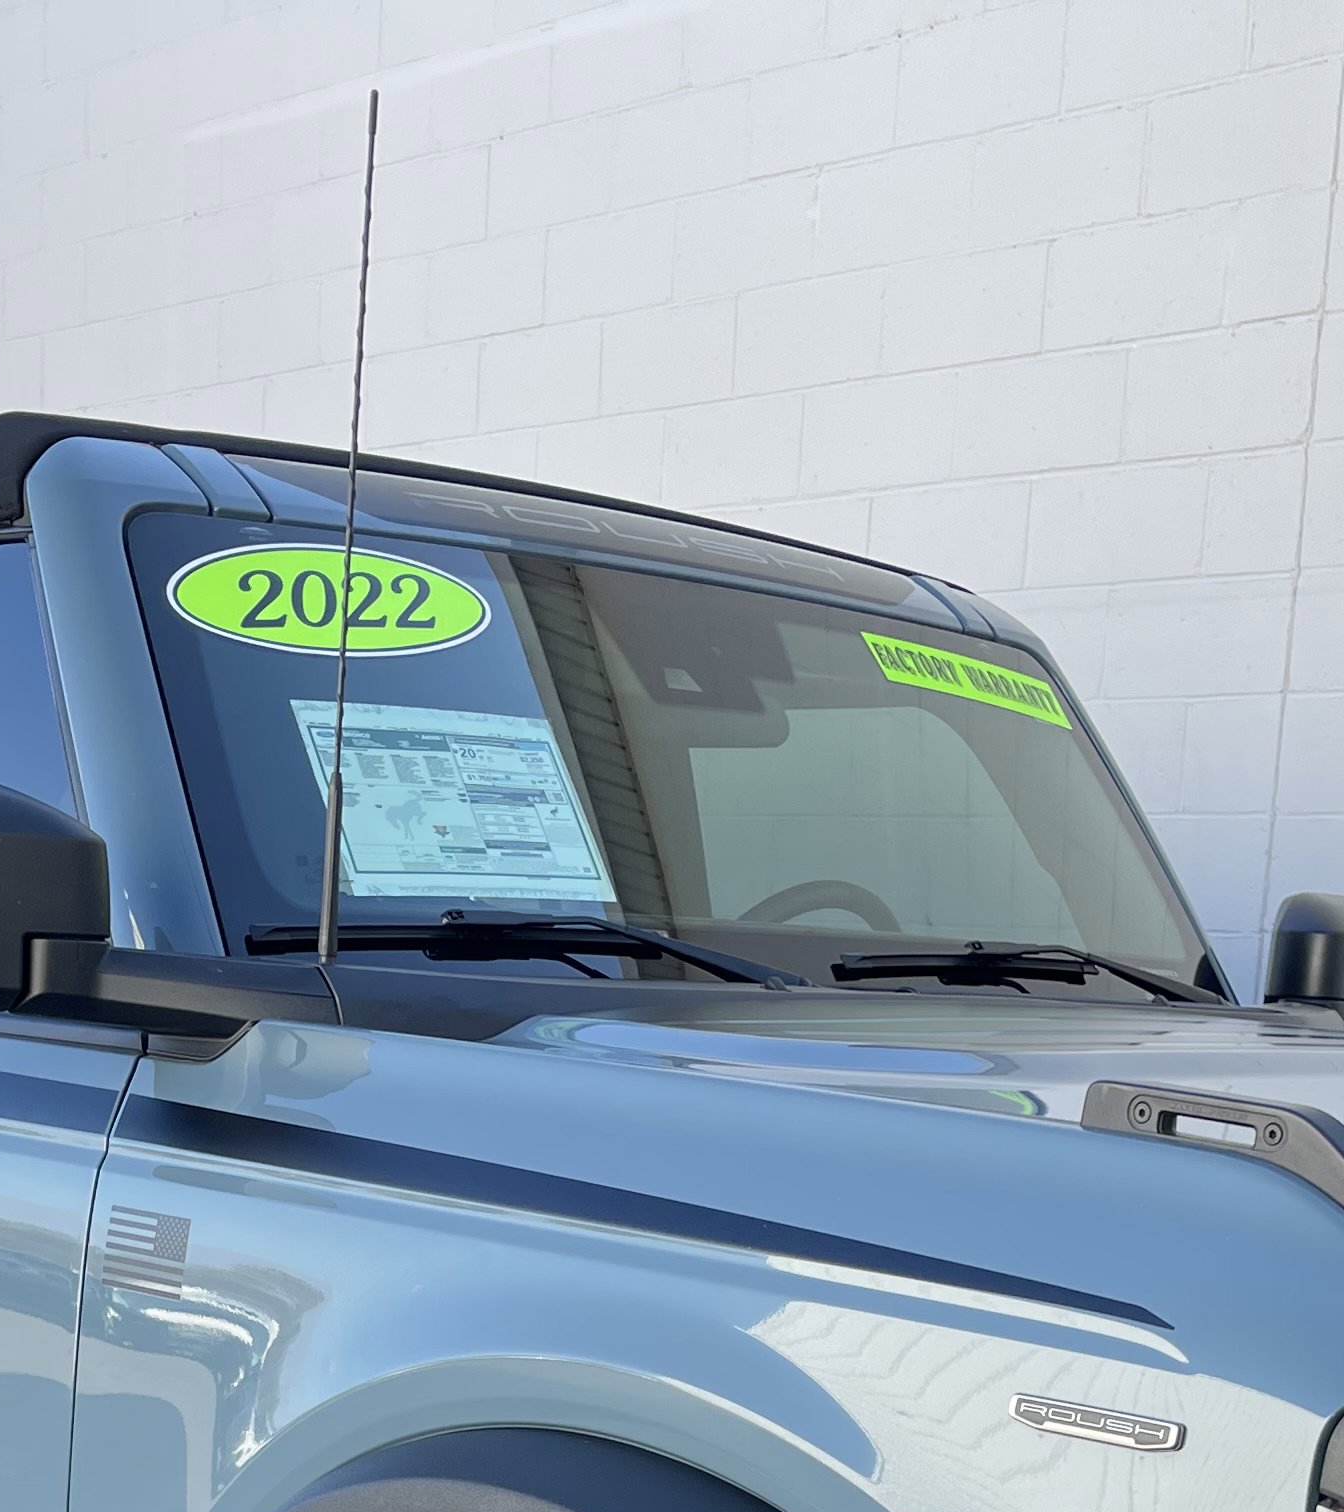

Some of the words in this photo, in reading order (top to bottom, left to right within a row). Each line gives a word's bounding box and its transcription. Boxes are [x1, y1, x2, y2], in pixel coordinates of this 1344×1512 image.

[405, 491, 846, 583] ROUSH
[238, 569, 437, 629] 2022
[871, 641, 964, 688] FACTORY
[960, 662, 1061, 718] WARRANTY
[459, 747, 477, 759] 20
[1019, 1401, 1165, 1440] ROUSH
